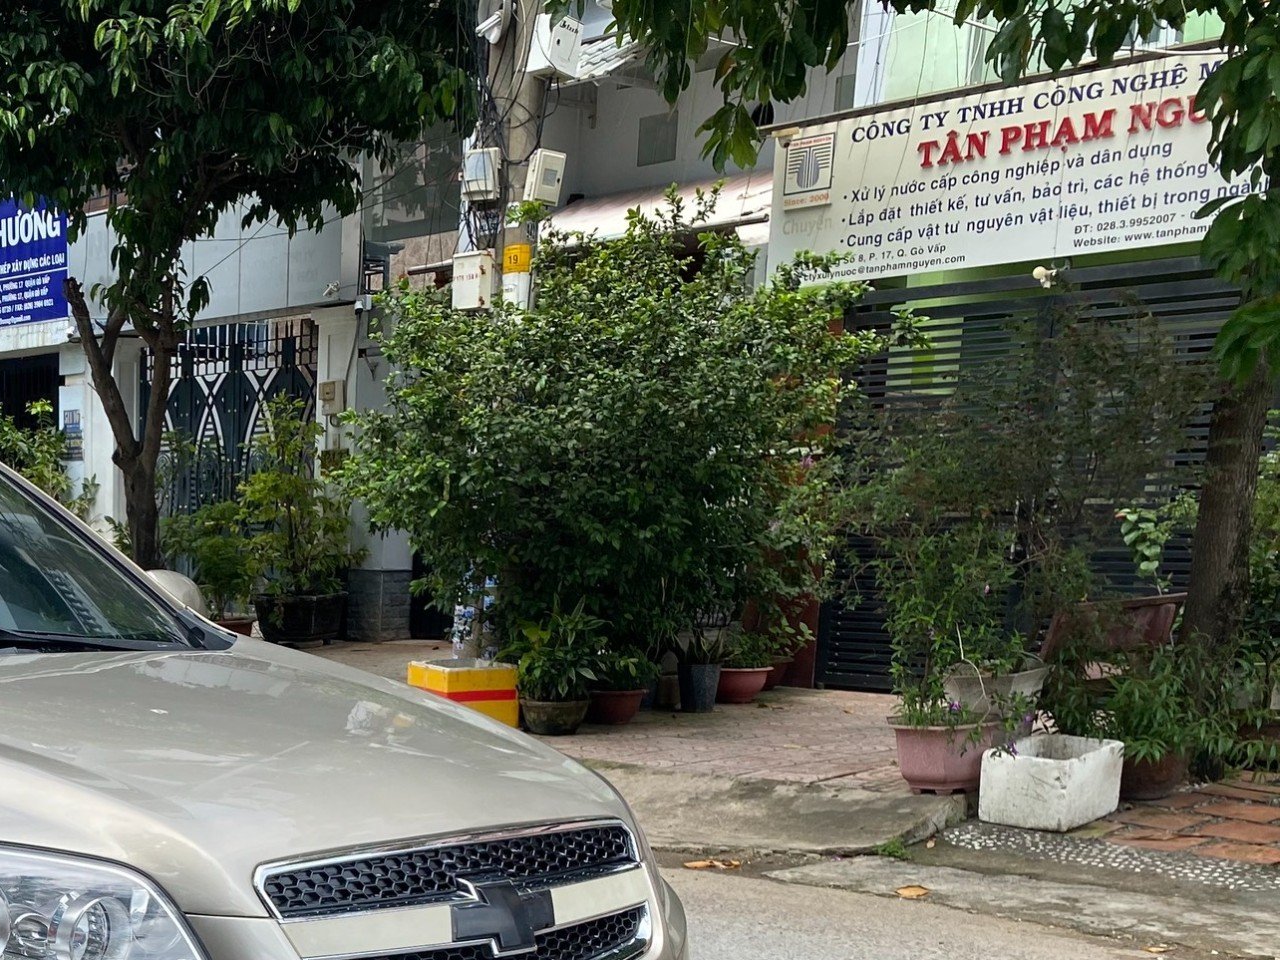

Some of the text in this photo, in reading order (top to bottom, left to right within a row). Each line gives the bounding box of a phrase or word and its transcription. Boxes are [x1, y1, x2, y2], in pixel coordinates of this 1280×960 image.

[851, 119, 912, 142] CÔNG
[920, 111, 949, 130] TY
[957, 97, 1025, 123] TNHH
[1033, 81, 1104, 109] CÔNG
[1110, 63, 1188, 96] NGHỆ
[917, 129, 991, 169] TÂN
[999, 108, 1117, 155] PHẠM
[851, 142, 1173, 202] Xử lý nước cấp công nghiệp và dân dụng
[849, 160, 1208, 226] Lắp đặt thiết kế, tư vấn, bảo trì, các hệ thống
[782, 217, 833, 237] Chuyên
[847, 233, 882, 247] Cung
[888, 226, 912, 242] cấp
[918, 224, 940, 240] vật
[945, 221, 960, 234] tư
[966, 213, 1024, 233] nguyên
[1030, 207, 1053, 224] vật
[1059, 202, 1093, 220] liệu,
[1098, 193, 1136, 214] thiết
[1141, 191, 1157, 209] bị
[1164, 187, 1210, 206] trong
[1073, 224, 1212, 248] Website: www.tanpham
[1074, 224, 1093, 235] ĐT:
[12, 260, 23, 272] XÂY
[24, 258, 38, 271] DỰNG
[40, 254, 51, 268] CÁC
[52, 253, 65, 266] LOẠI
[508, 254, 519, 265] 19
[868, 253, 878, 261] P.
[881, 251, 894, 260] 17,
[897, 249, 907, 258] Q.
[910, 246, 924, 255] Gò
[927, 243, 946, 254] Vấp
